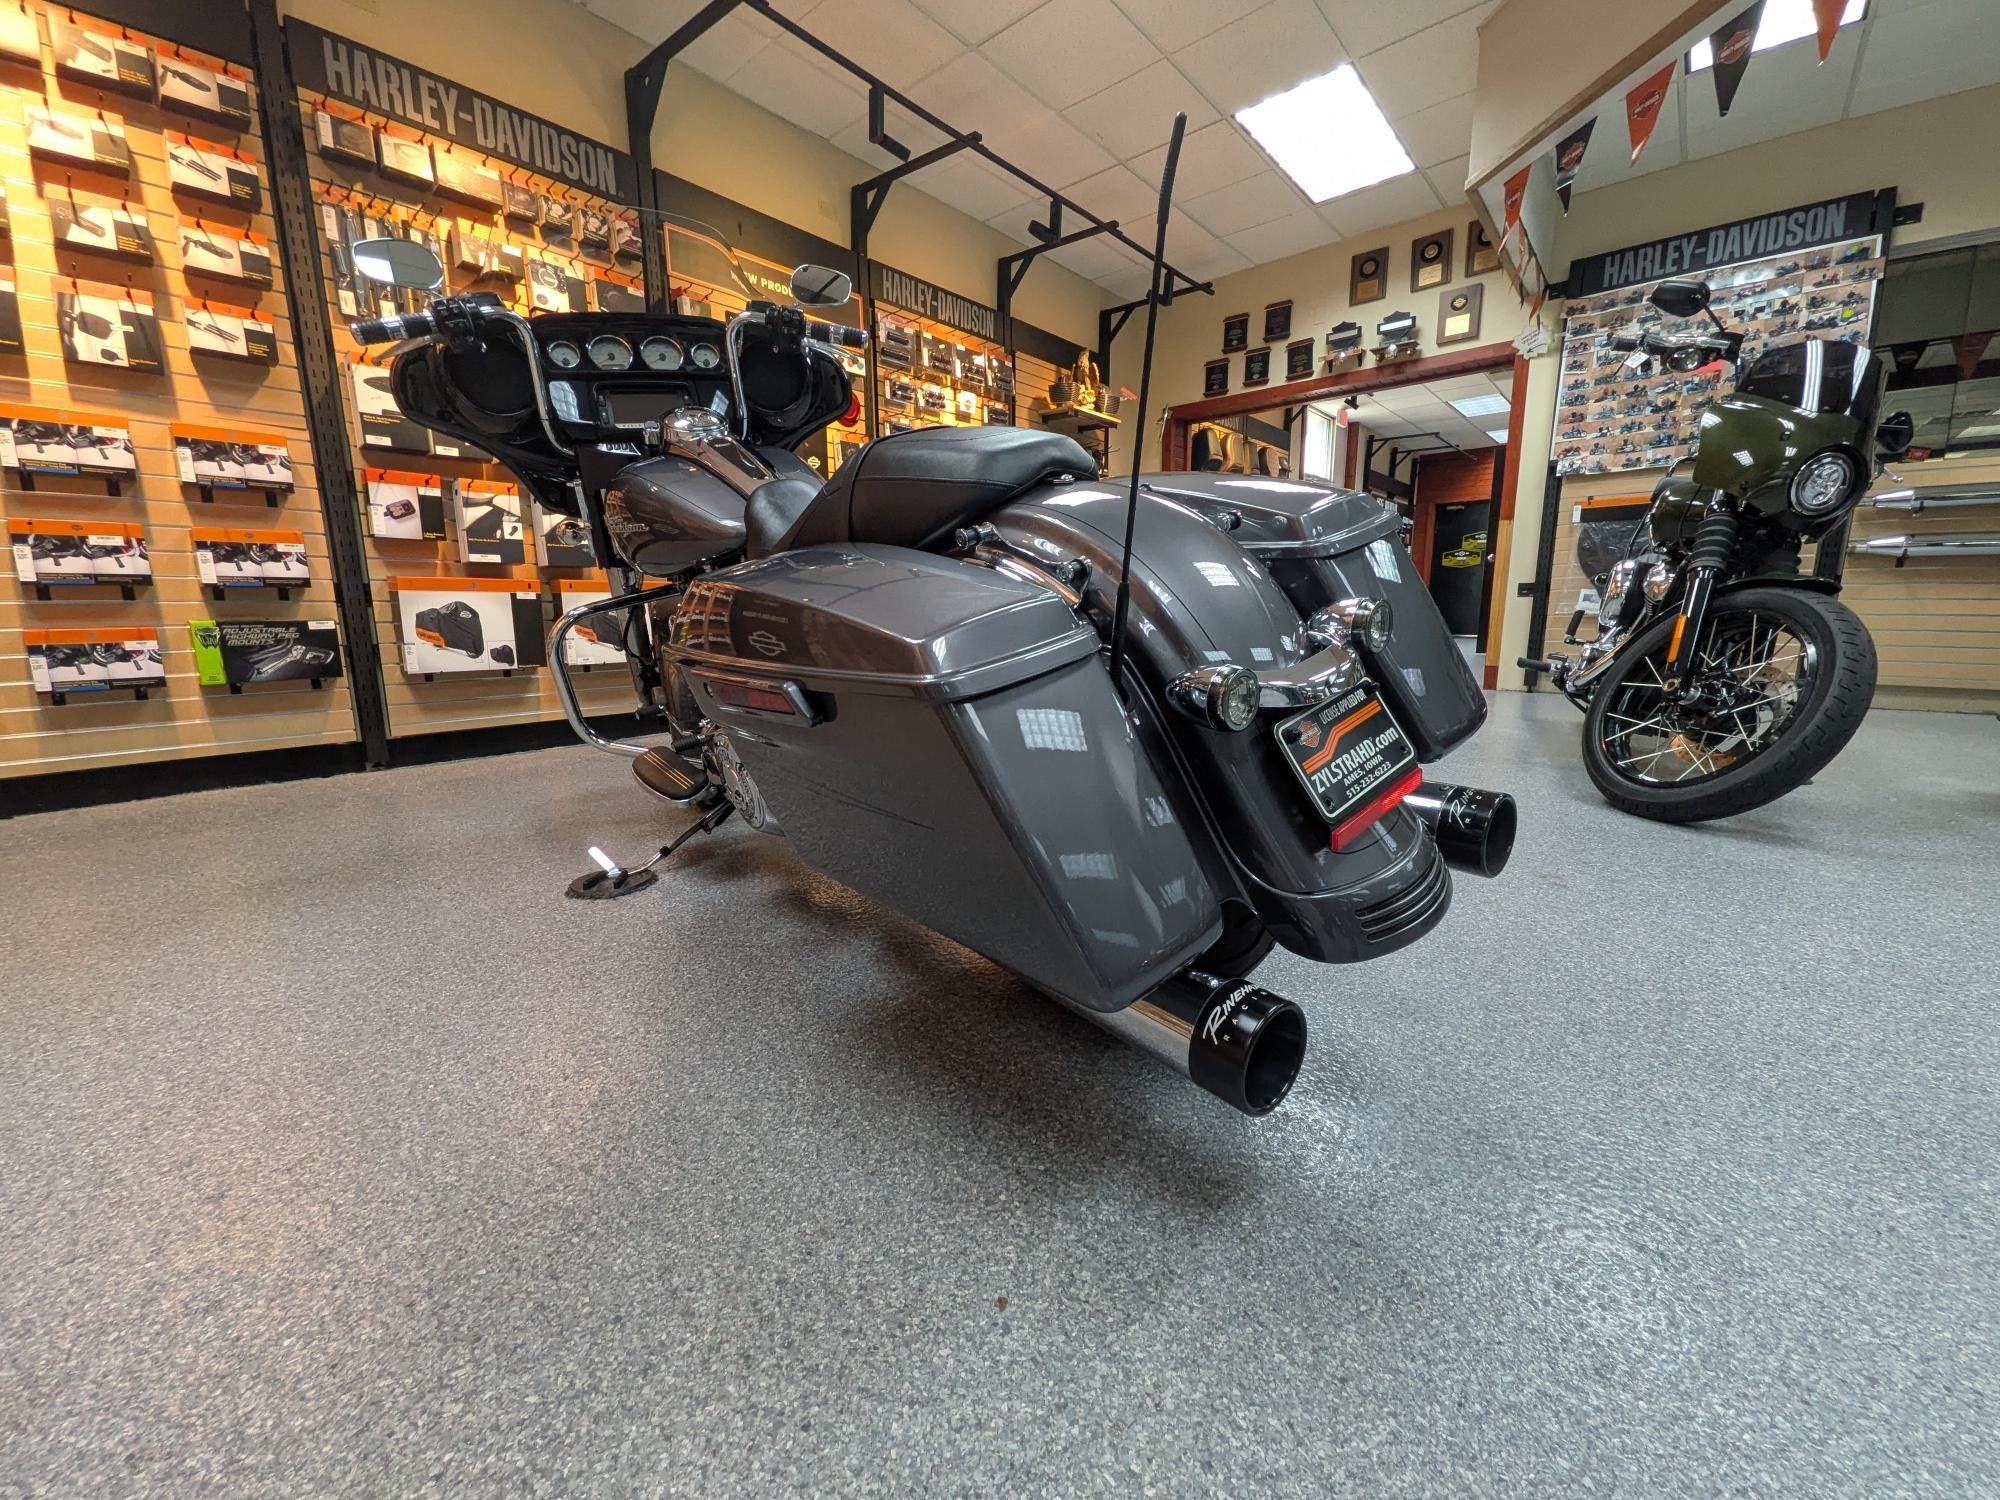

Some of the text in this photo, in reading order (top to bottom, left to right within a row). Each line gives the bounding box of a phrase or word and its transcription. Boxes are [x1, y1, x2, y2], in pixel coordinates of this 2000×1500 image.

[321, 36, 618, 196] HARLEY-DAVIDSON
[1602, 201, 1849, 288] HARLEY-DAVIDSON
[882, 268, 995, 339] HARLEY-DAVIDSON
[223, 627, 297, 635] ADJUSTABLE
[226, 632, 275, 640] HIGHWAY
[227, 638, 275, 646] MOUNTS
[1319, 688, 1368, 725] LICENSE APPLIED FOR
[1343, 755, 1384, 787] AMES, IOWA
[1346, 761, 1392, 799] 515-232-6223
